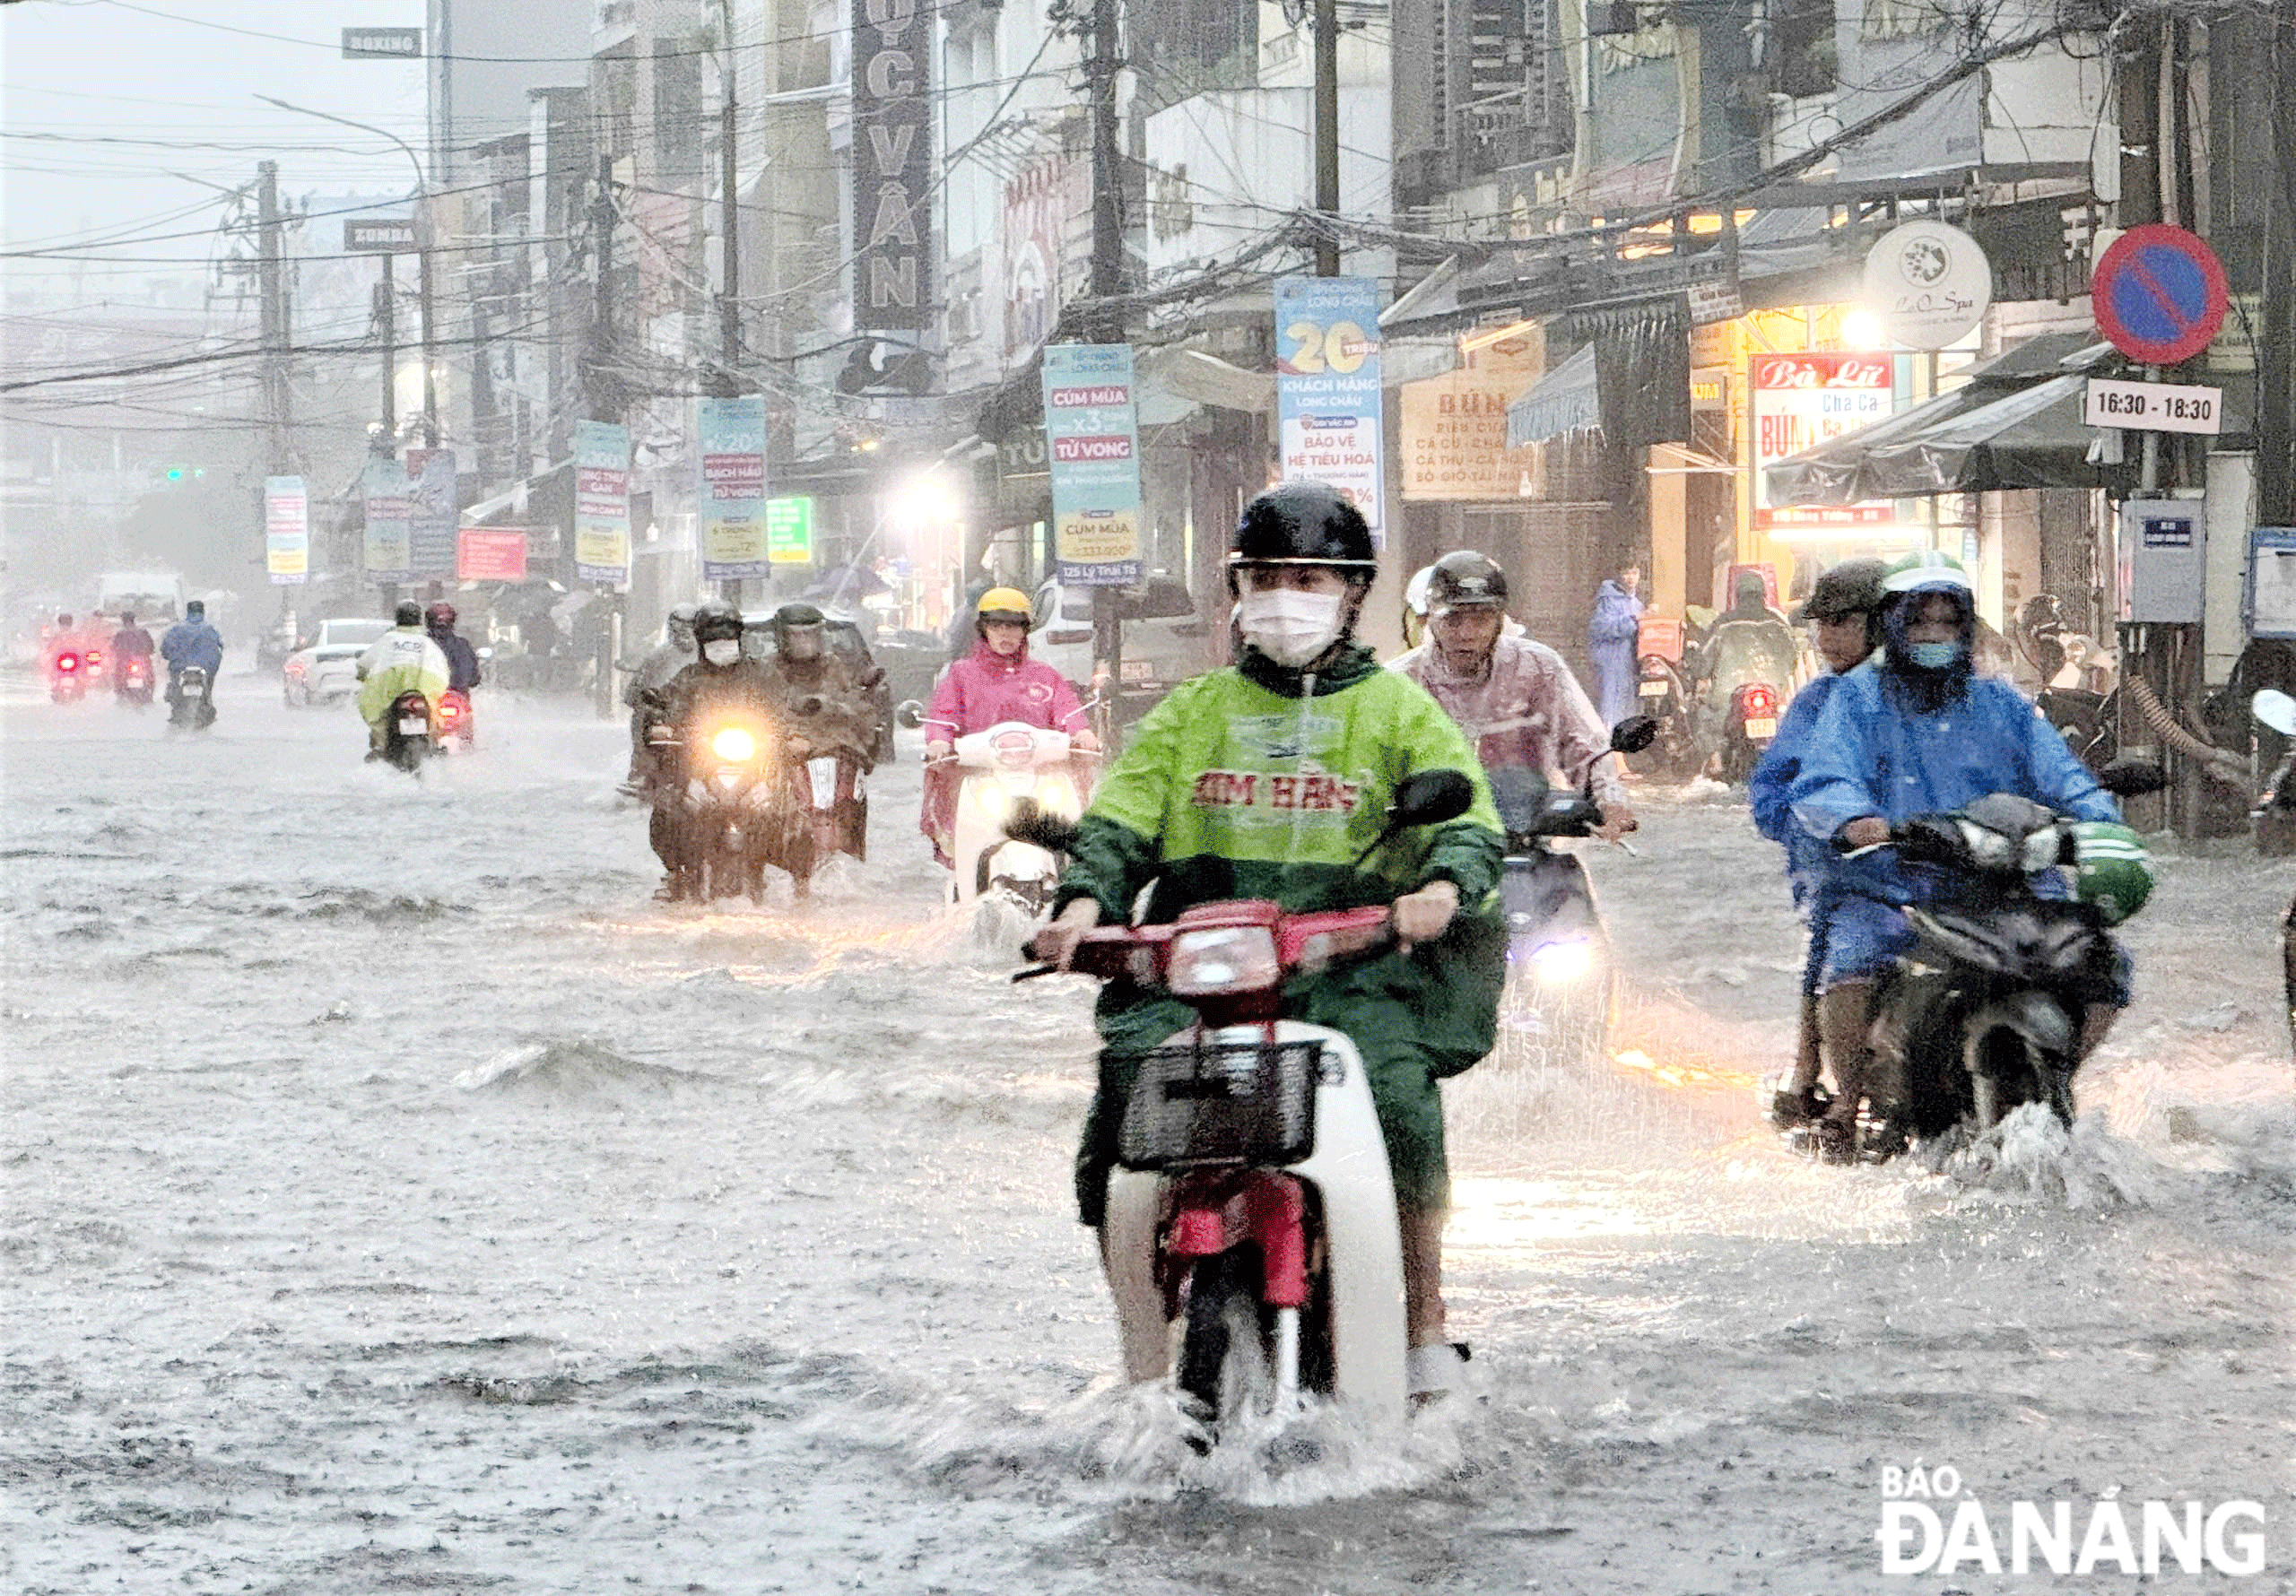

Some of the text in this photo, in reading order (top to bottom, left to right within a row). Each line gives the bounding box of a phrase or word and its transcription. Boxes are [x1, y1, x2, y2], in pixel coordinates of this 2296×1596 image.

[351, 36, 413, 51] BOXING
[354, 228, 414, 242] ZUMBA
[1283, 376, 1333, 393] KHÁCH
[1295, 396, 1327, 407] LONG
[2098, 392, 2146, 415] 16:30
[2164, 397, 2212, 421] 18:30
[1761, 406, 1805, 457] BÚN
[1081, 441, 1130, 457] VONG
